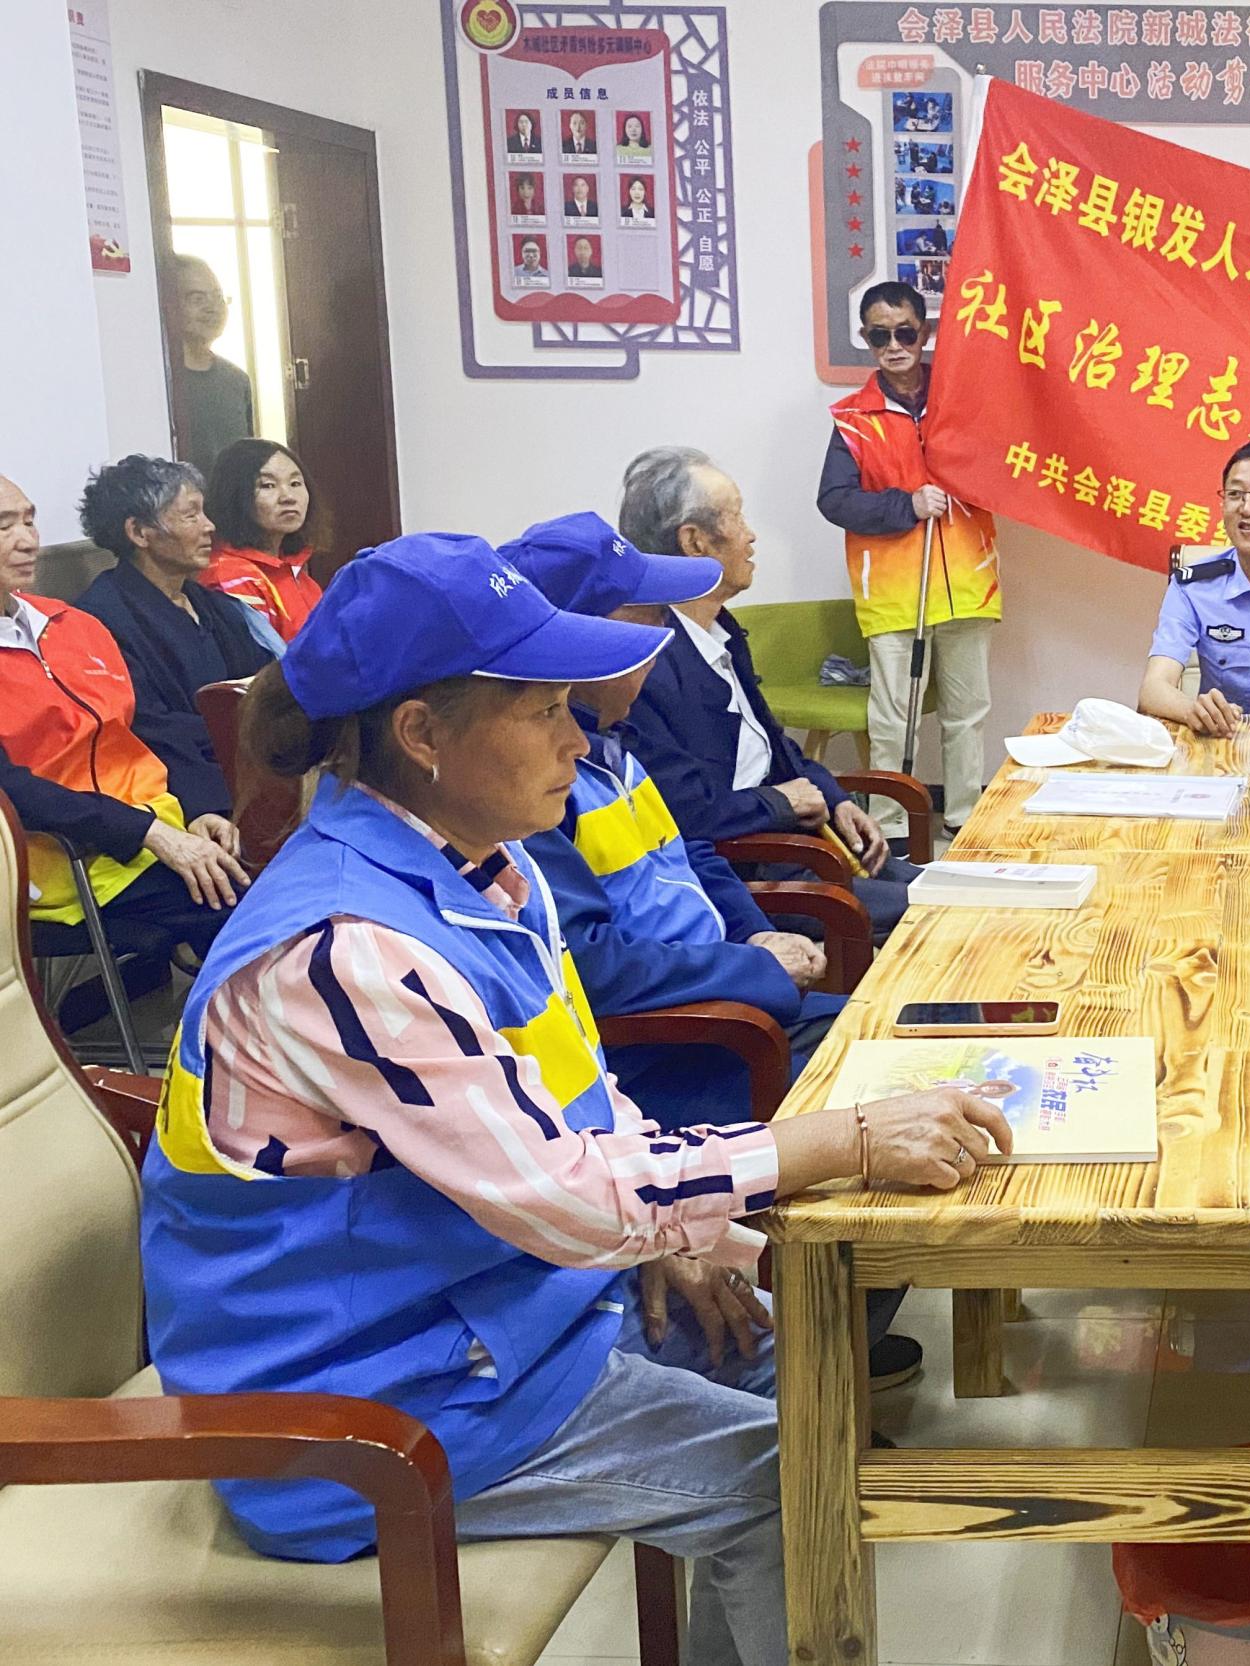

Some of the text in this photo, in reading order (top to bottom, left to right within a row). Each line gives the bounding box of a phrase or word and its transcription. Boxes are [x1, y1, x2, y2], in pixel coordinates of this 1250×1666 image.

[546, 87, 609, 100] 成员信息
[692, 89, 715, 272] 依法 公平 公正 自愿
